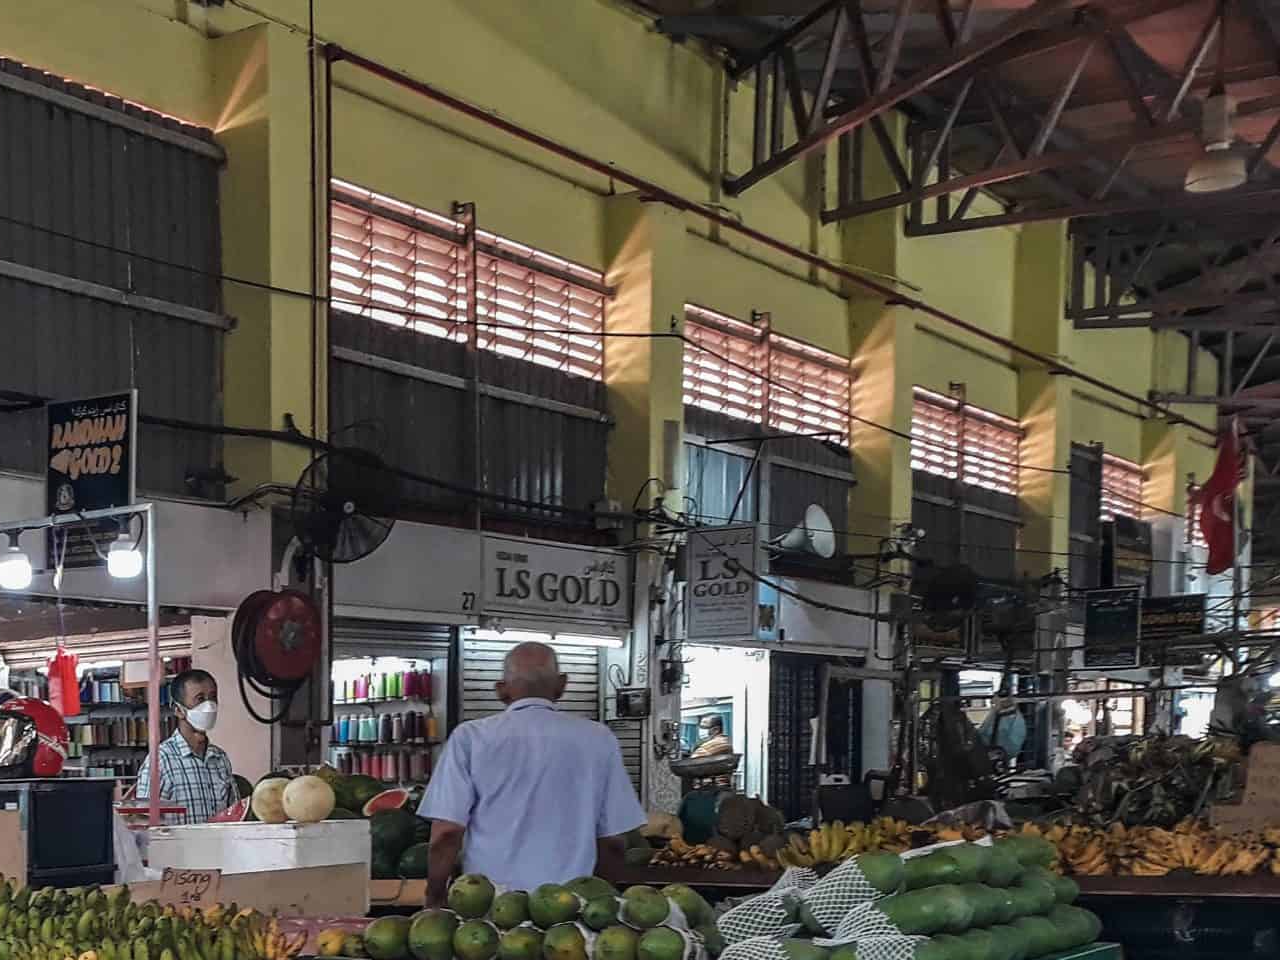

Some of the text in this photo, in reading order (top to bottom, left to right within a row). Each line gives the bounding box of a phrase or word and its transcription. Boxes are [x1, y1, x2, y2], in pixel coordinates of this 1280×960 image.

[495, 567, 621, 607] LS GOLD
[692, 580, 750, 598] GOLD
